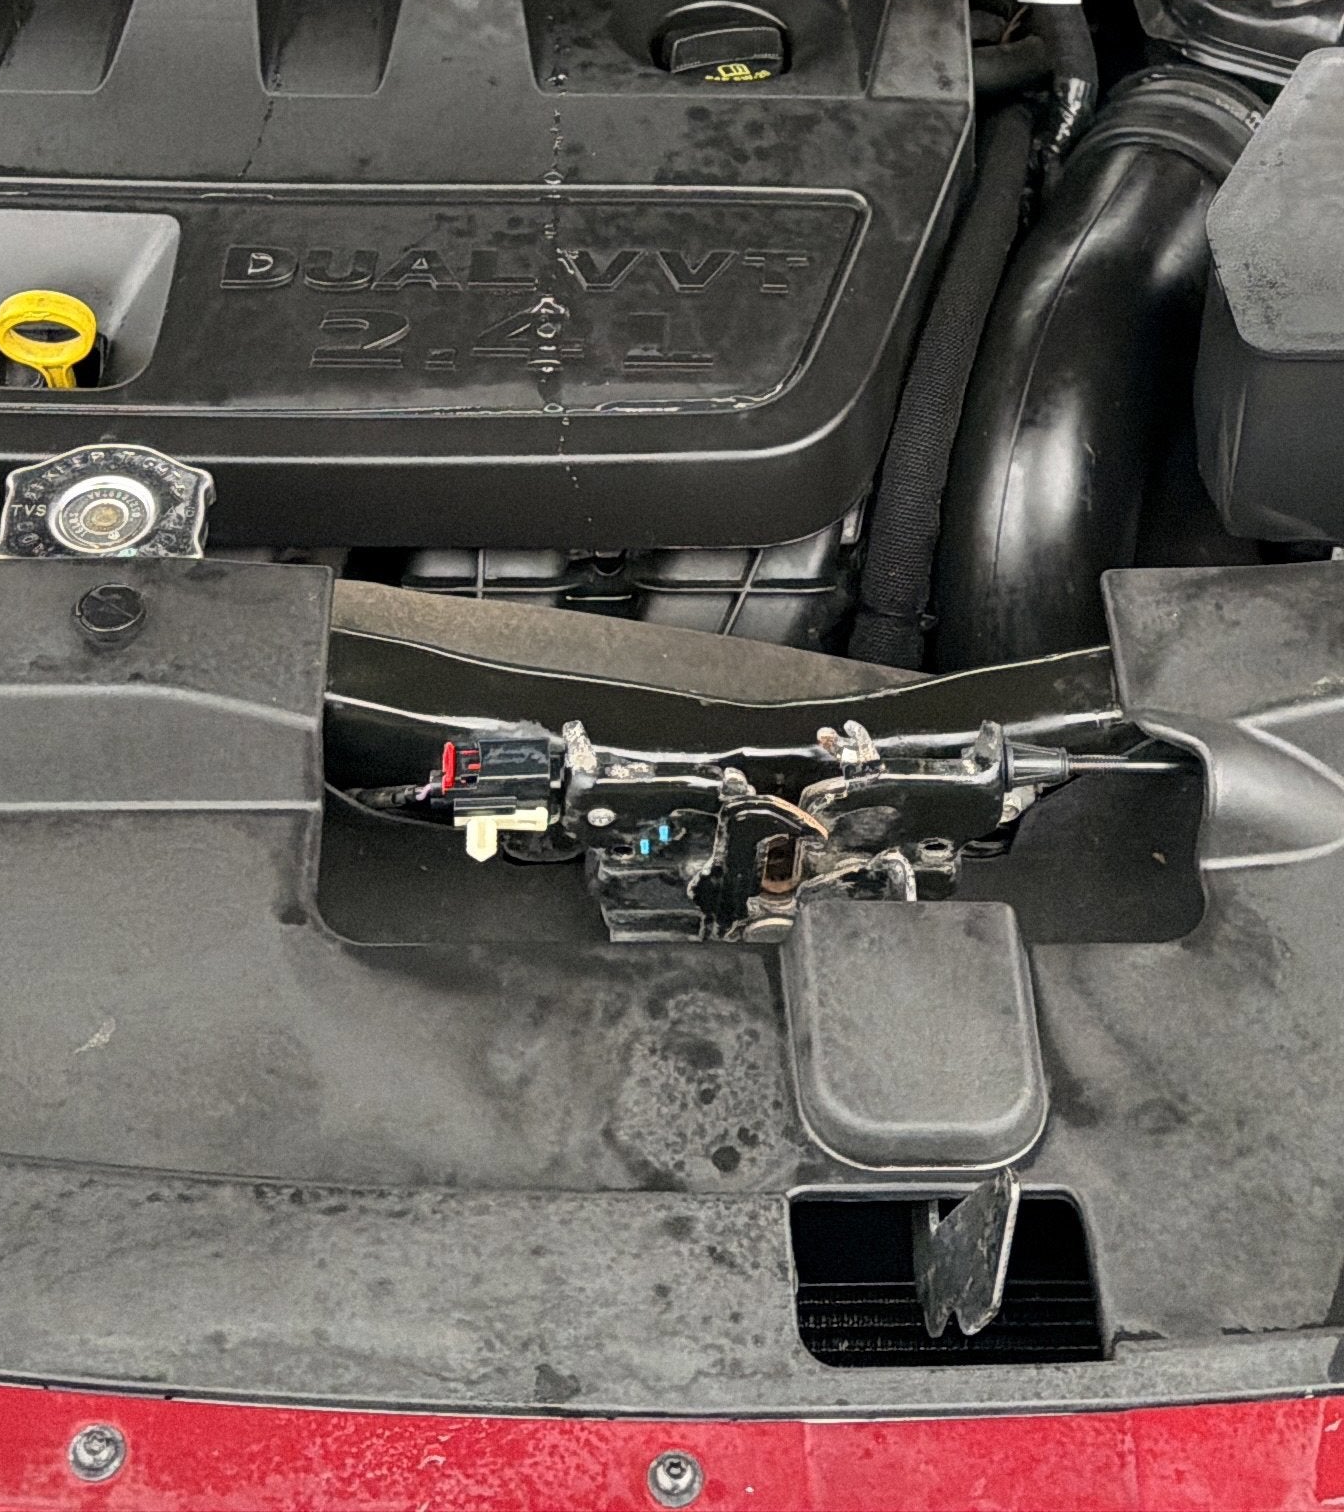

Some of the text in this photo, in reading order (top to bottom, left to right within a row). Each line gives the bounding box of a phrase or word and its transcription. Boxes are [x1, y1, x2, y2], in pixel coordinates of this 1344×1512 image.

[220, 243, 811, 294] DUAL VVT
[10, 503, 47, 517] TVS
